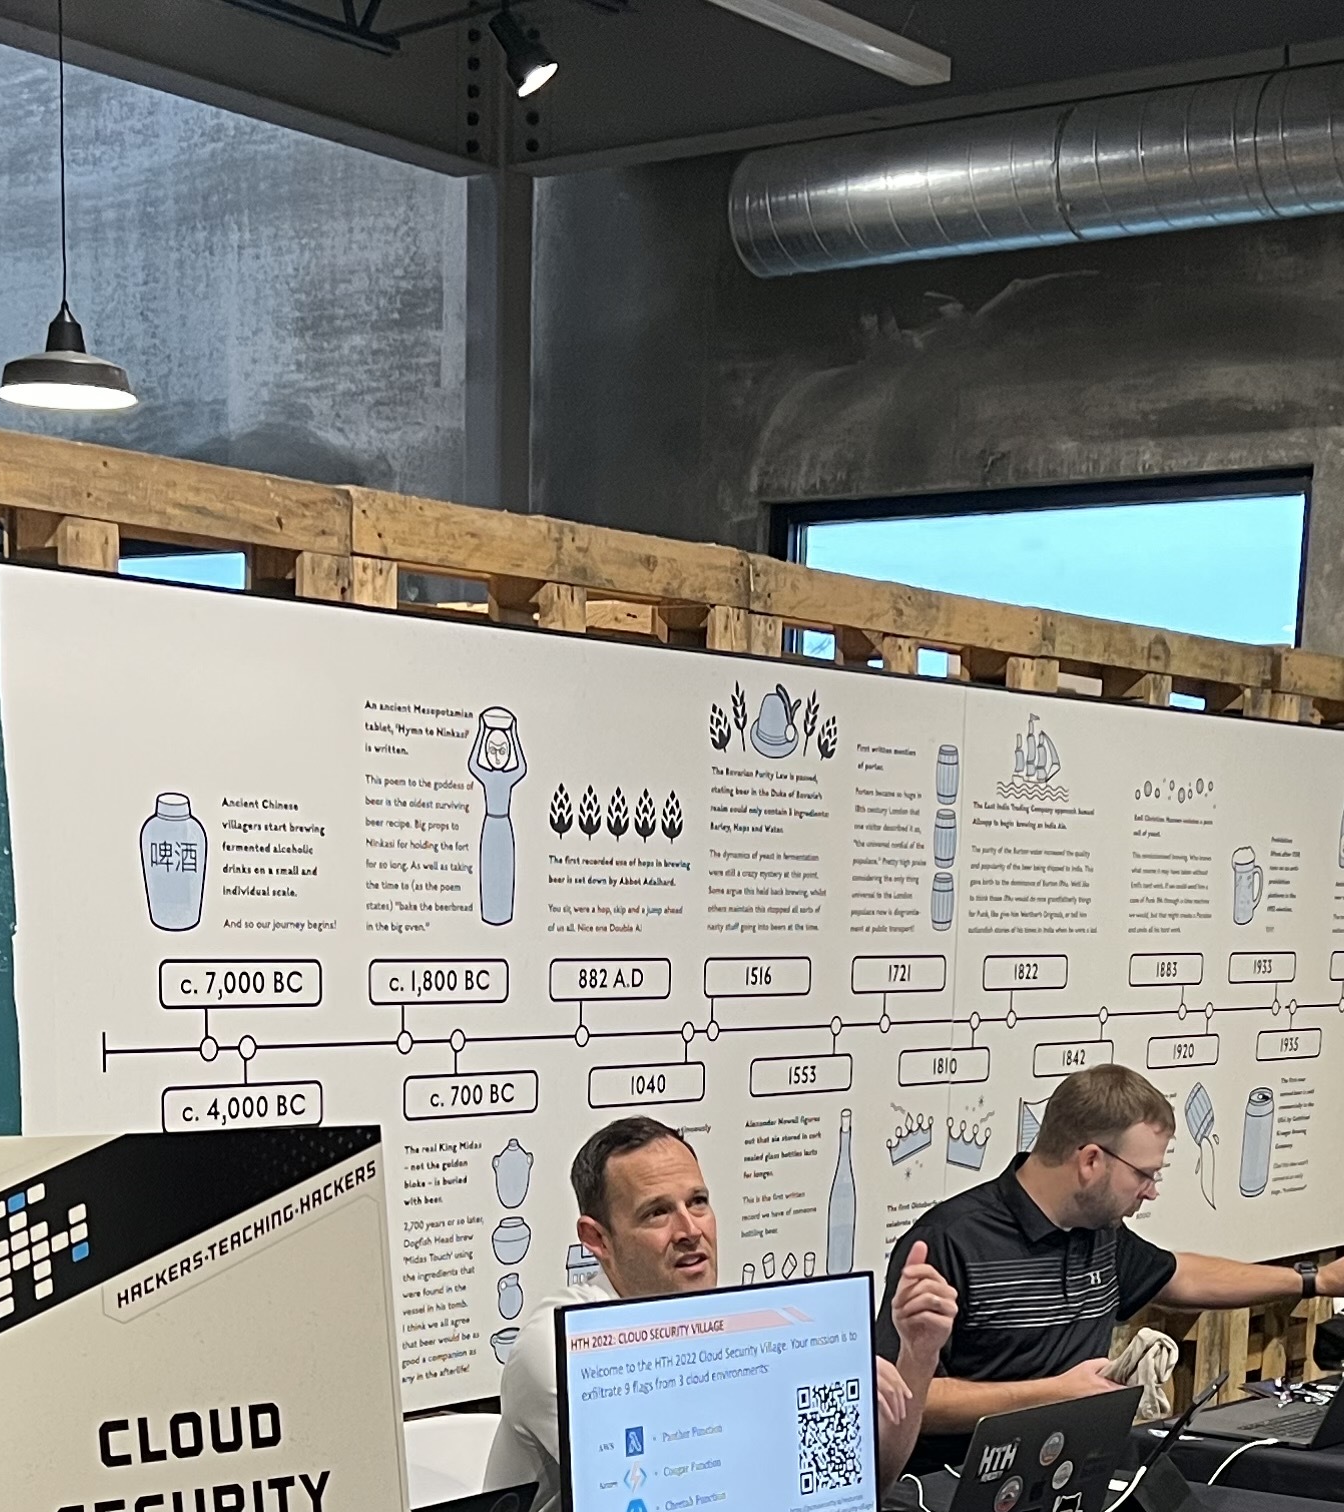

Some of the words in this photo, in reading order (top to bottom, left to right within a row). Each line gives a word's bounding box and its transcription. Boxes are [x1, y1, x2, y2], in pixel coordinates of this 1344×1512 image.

[221, 797, 259, 810] Ancient
[261, 799, 299, 812] Chinese
[221, 819, 262, 834] villagers
[263, 822, 287, 832] start
[289, 822, 325, 837] brewing
[150, 840, 198, 874] 啤酒
[221, 840, 271, 853] fermented
[272, 843, 313, 855] alcoholic
[222, 863, 252, 874] drinks
[267, 867, 274, 875] a
[275, 865, 299, 875] small
[301, 866, 318, 876] and
[745, 965, 772, 986] 1516
[888, 963, 911, 982] 1721
[1014, 962, 1038, 980] 1822
[1156, 960, 1178, 978] 1883
[1253, 958, 1272, 974] 1933
[180, 978, 198, 995] c.
[205, 970, 265, 1001] 7,000
[273, 970, 303, 994] BC
[388, 977, 404, 992] c.
[411, 969, 457, 998] 1,800
[464, 969, 490, 991] BC
[578, 967, 608, 989] 882
[612, 967, 644, 988] A.D
[1173, 1042, 1196, 1060] 1920
[1279, 1036, 1299, 1052] 1935
[932, 1057, 957, 1075] 1810
[1062, 1048, 1086, 1066] 1842
[631, 1073, 666, 1095] 1040
[788, 1064, 816, 1085] 1553
[429, 1093, 444, 1107] c.
[450, 1083, 483, 1106] 700
[489, 1082, 515, 1104] BC
[182, 1106, 199, 1122] c.
[206, 1095, 268, 1126] 4,000
[276, 1093, 306, 1117] BC
[570, 1337, 590, 1350] HTH
[591, 1333, 617, 1349] 2022:
[618, 1329, 648, 1345] CLOUD
[649, 1324, 689, 1341] SECURITY
[690, 1319, 724, 1335] VILLAGE
[98, 1401, 282, 1468] CLOUD
